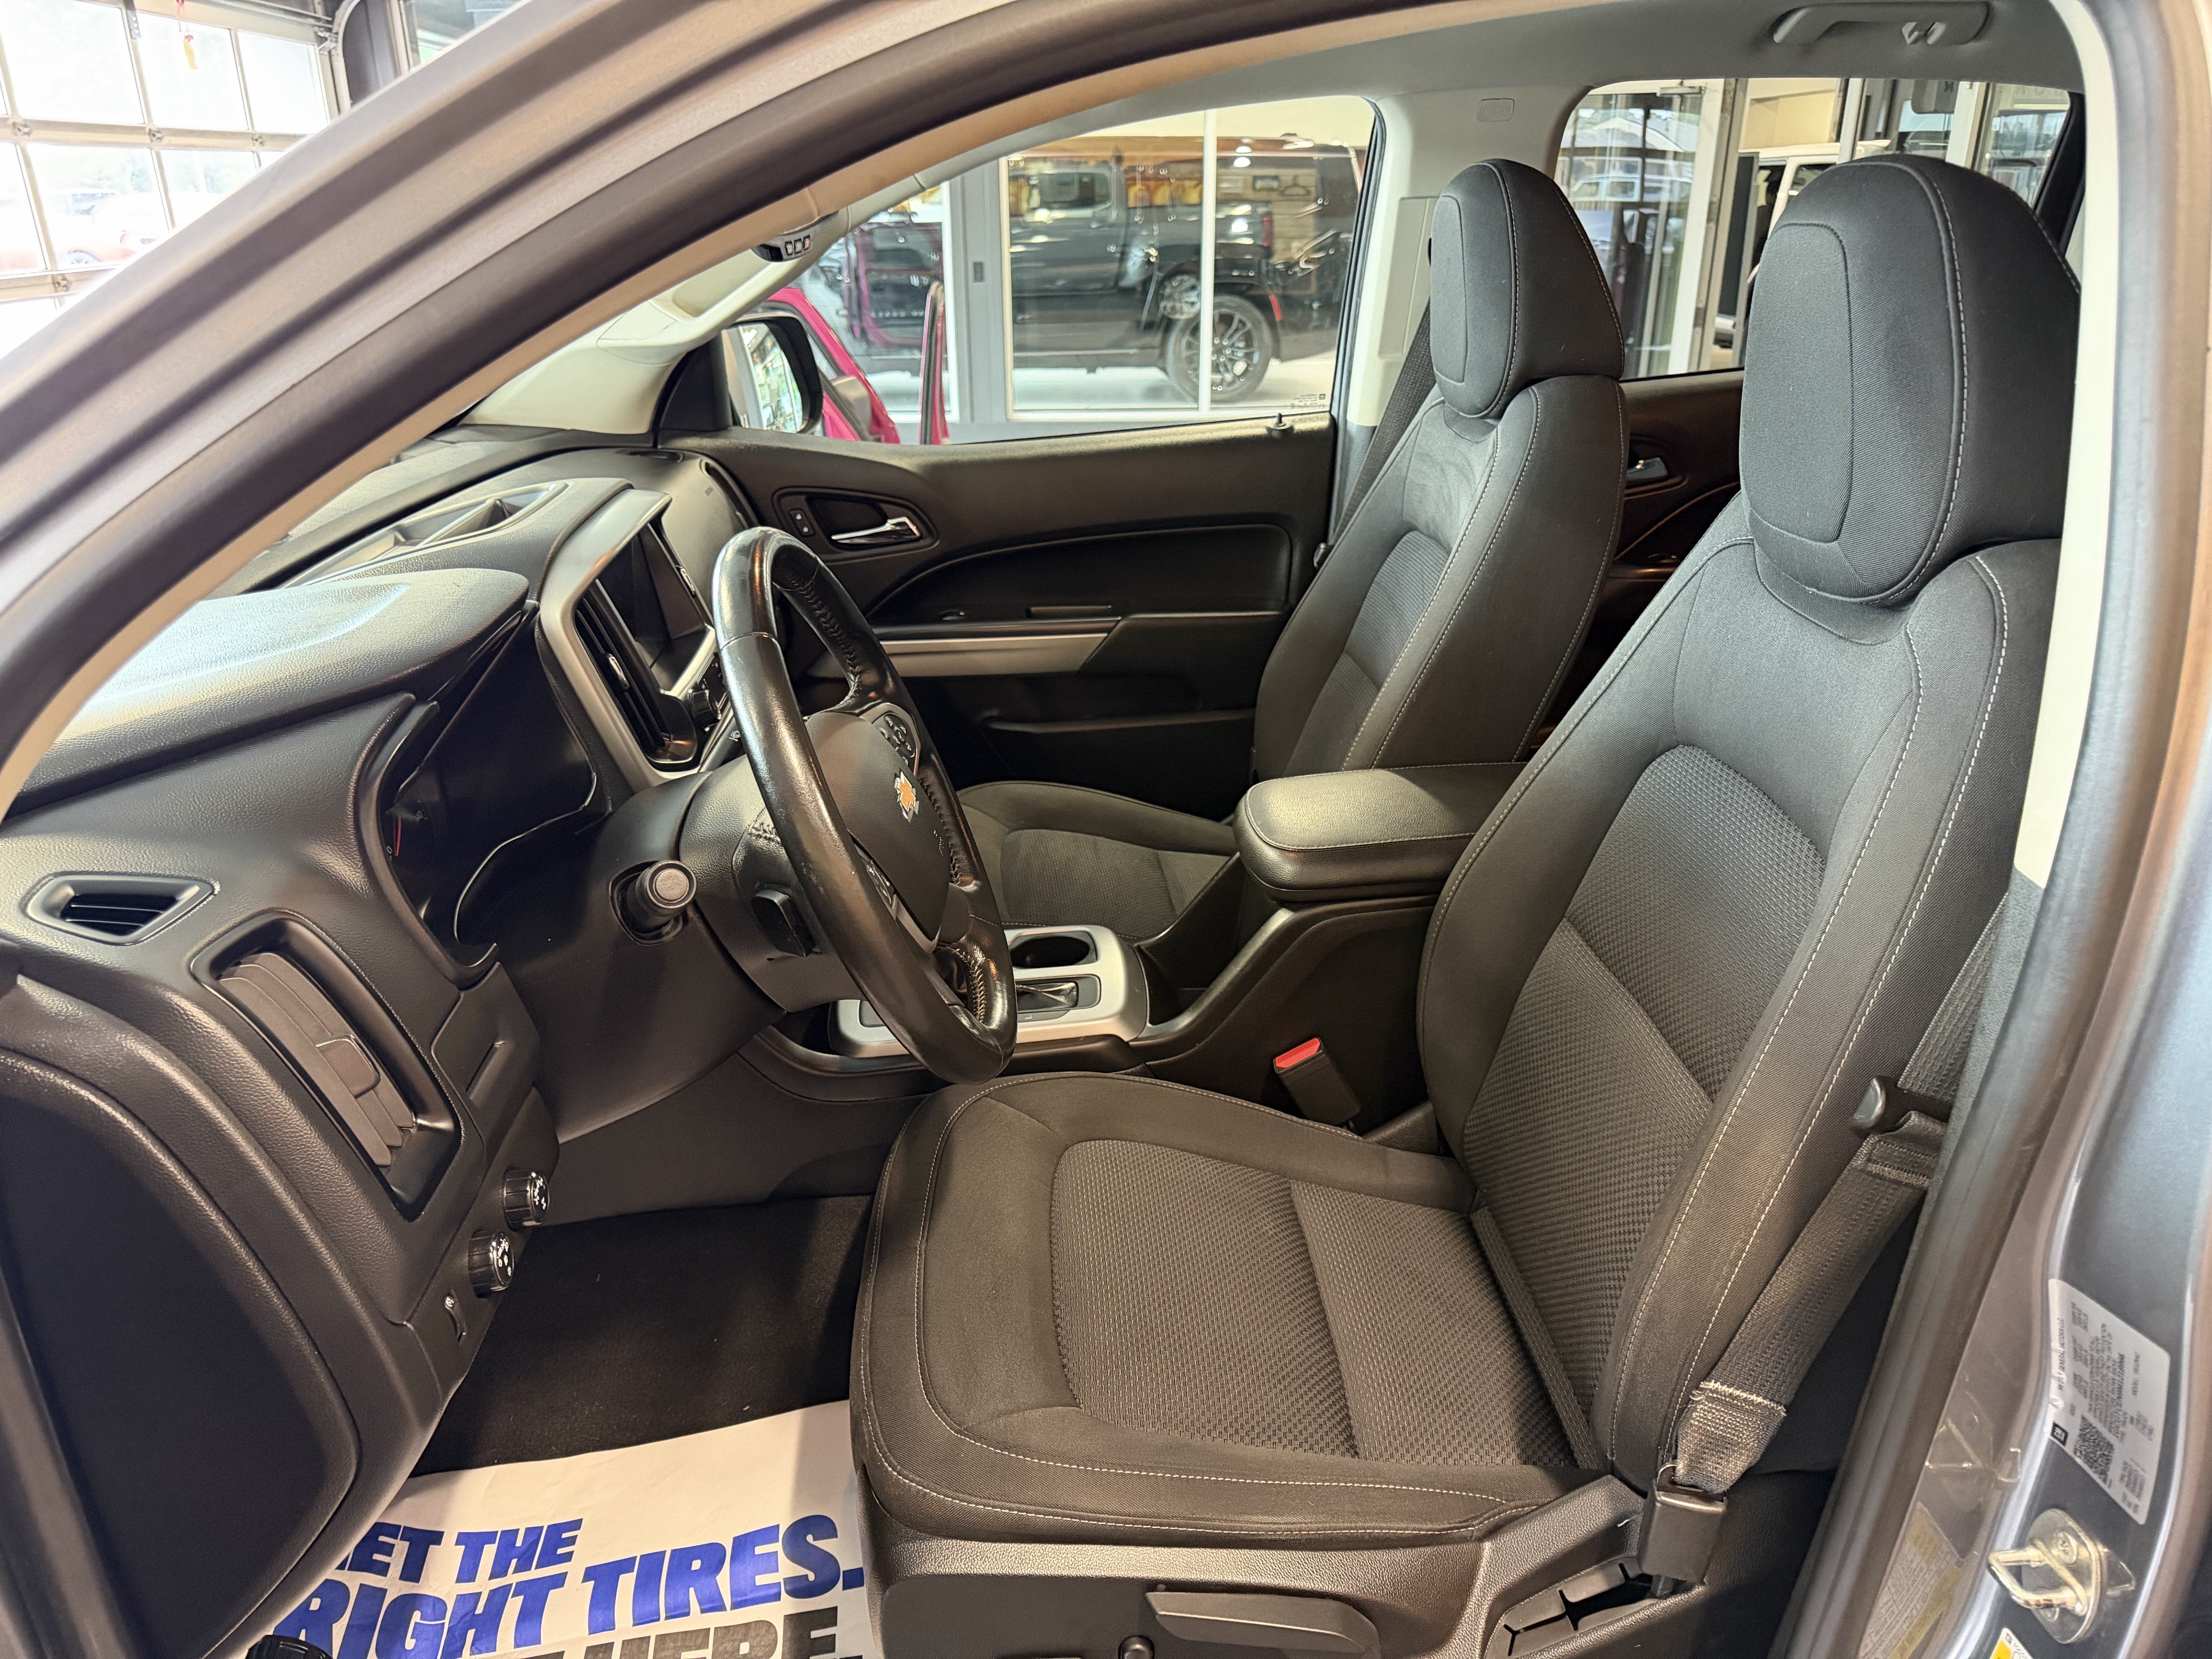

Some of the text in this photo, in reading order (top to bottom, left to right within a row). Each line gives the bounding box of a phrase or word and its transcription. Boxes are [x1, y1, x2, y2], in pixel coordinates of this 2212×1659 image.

[272, 1514, 865, 1659] RIGHT TIRES.
[335, 1518, 584, 1584] ET THE
